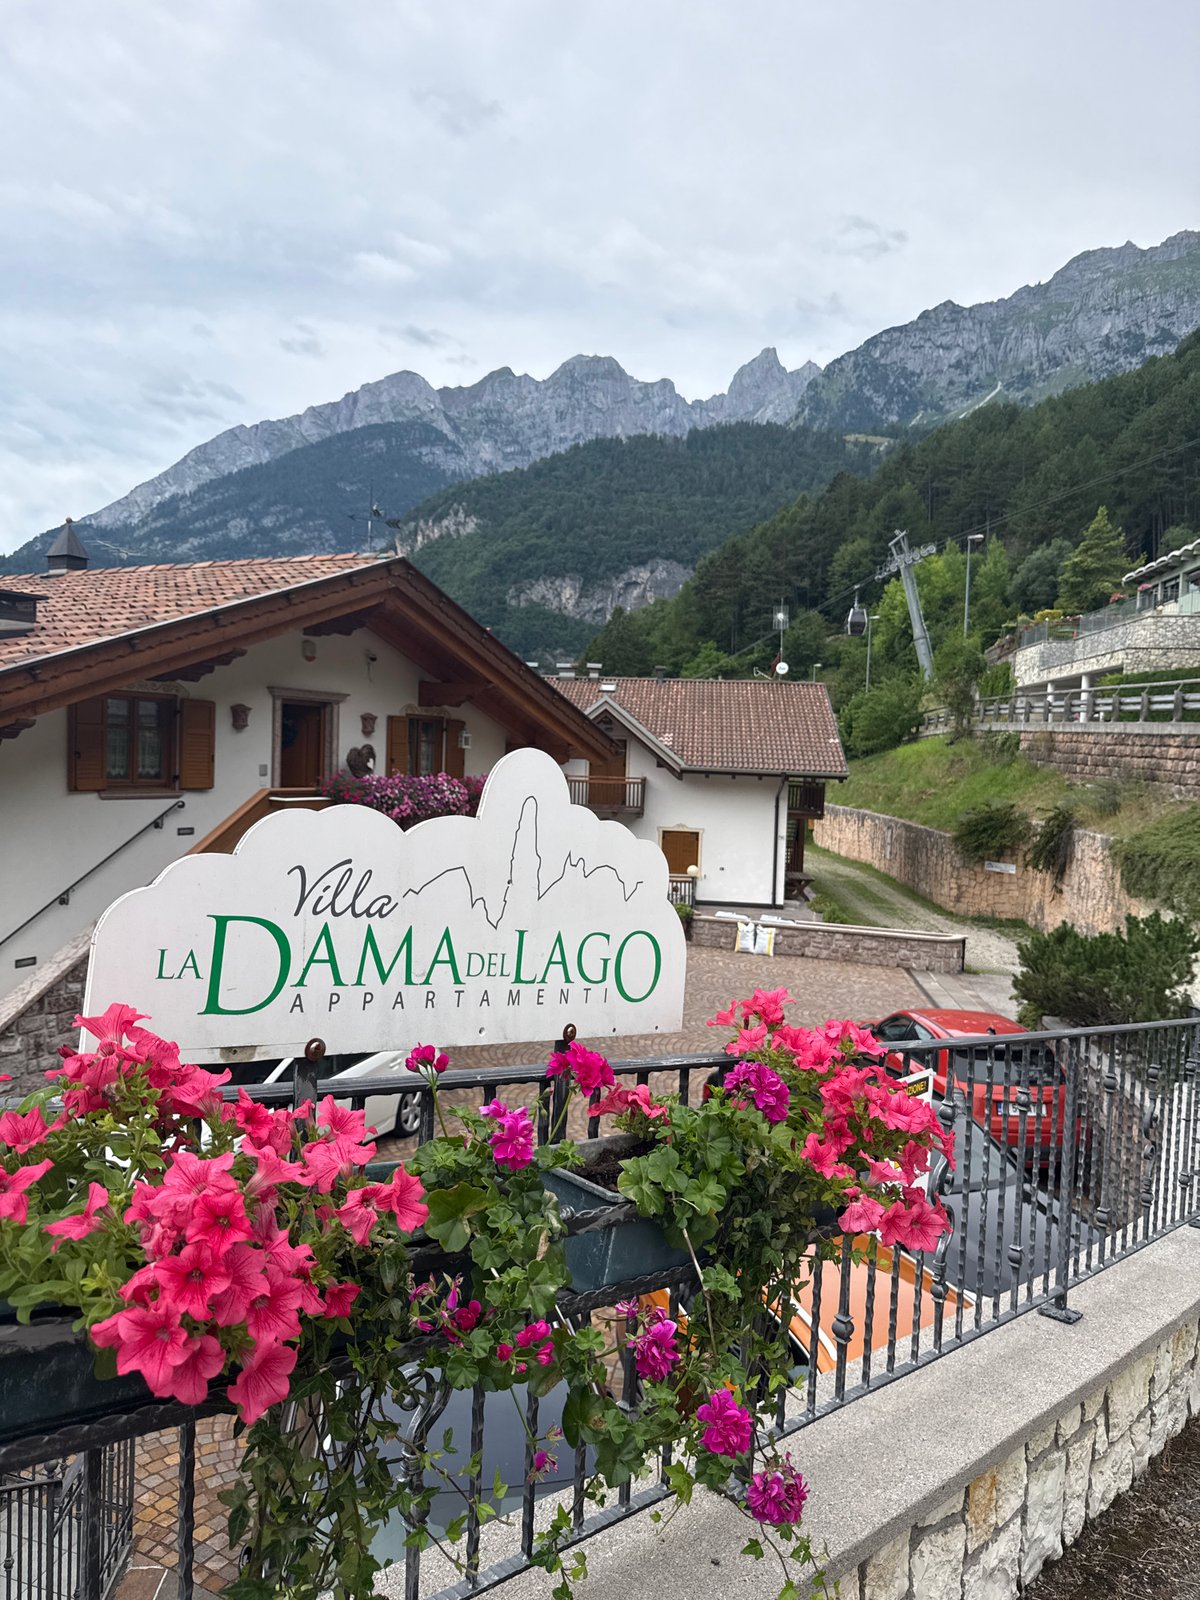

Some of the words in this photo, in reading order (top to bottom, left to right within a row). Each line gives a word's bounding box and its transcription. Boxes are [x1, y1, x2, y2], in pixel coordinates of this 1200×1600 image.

[287, 859, 399, 919] Villa
[156, 947, 204, 980] LA
[198, 914, 465, 1016] DAMA
[465, 951, 511, 977] DEL
[511, 929, 662, 1004] LAGO
[289, 987, 609, 1014] APPARTAMENTI
